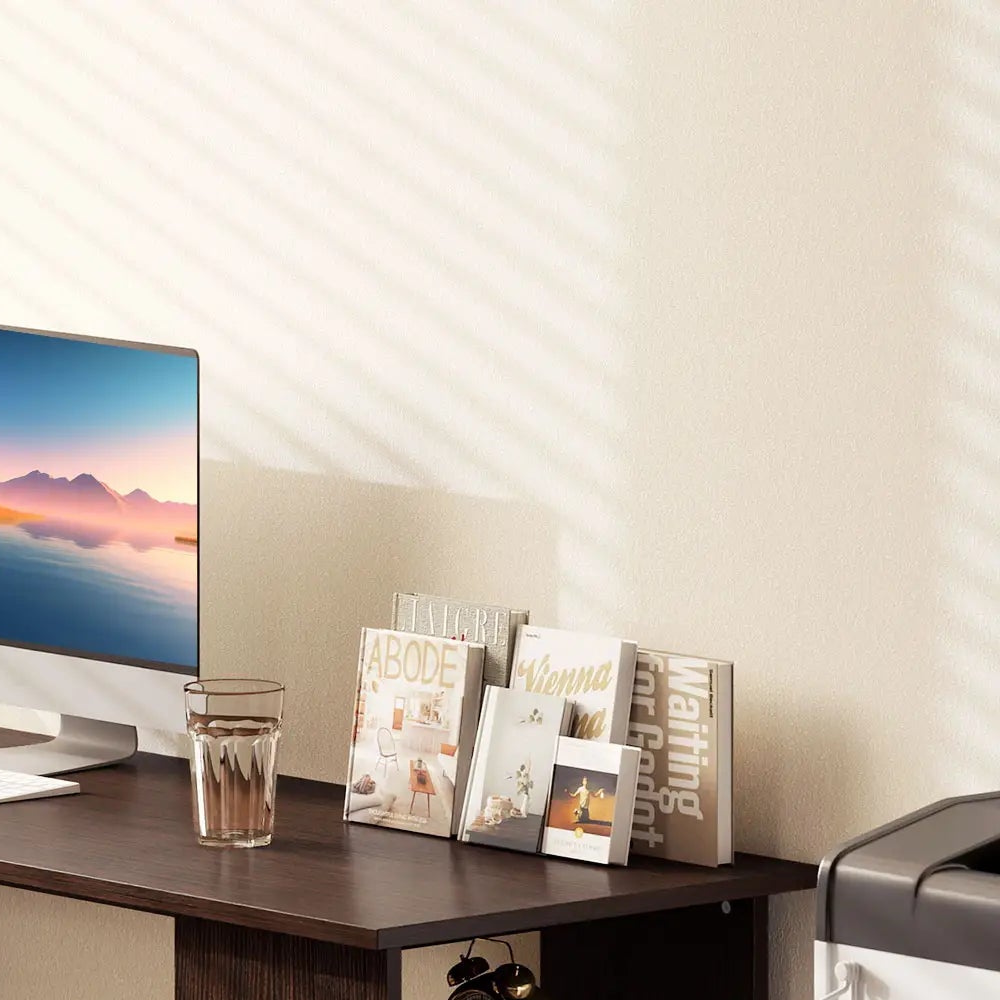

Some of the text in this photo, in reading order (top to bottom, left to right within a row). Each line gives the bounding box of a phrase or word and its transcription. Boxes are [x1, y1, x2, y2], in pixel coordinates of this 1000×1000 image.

[369, 633, 459, 689] ABODE
[517, 653, 613, 697] Vienna
[628, 653, 665, 848] for Godot
[668, 656, 708, 821] Waiting
